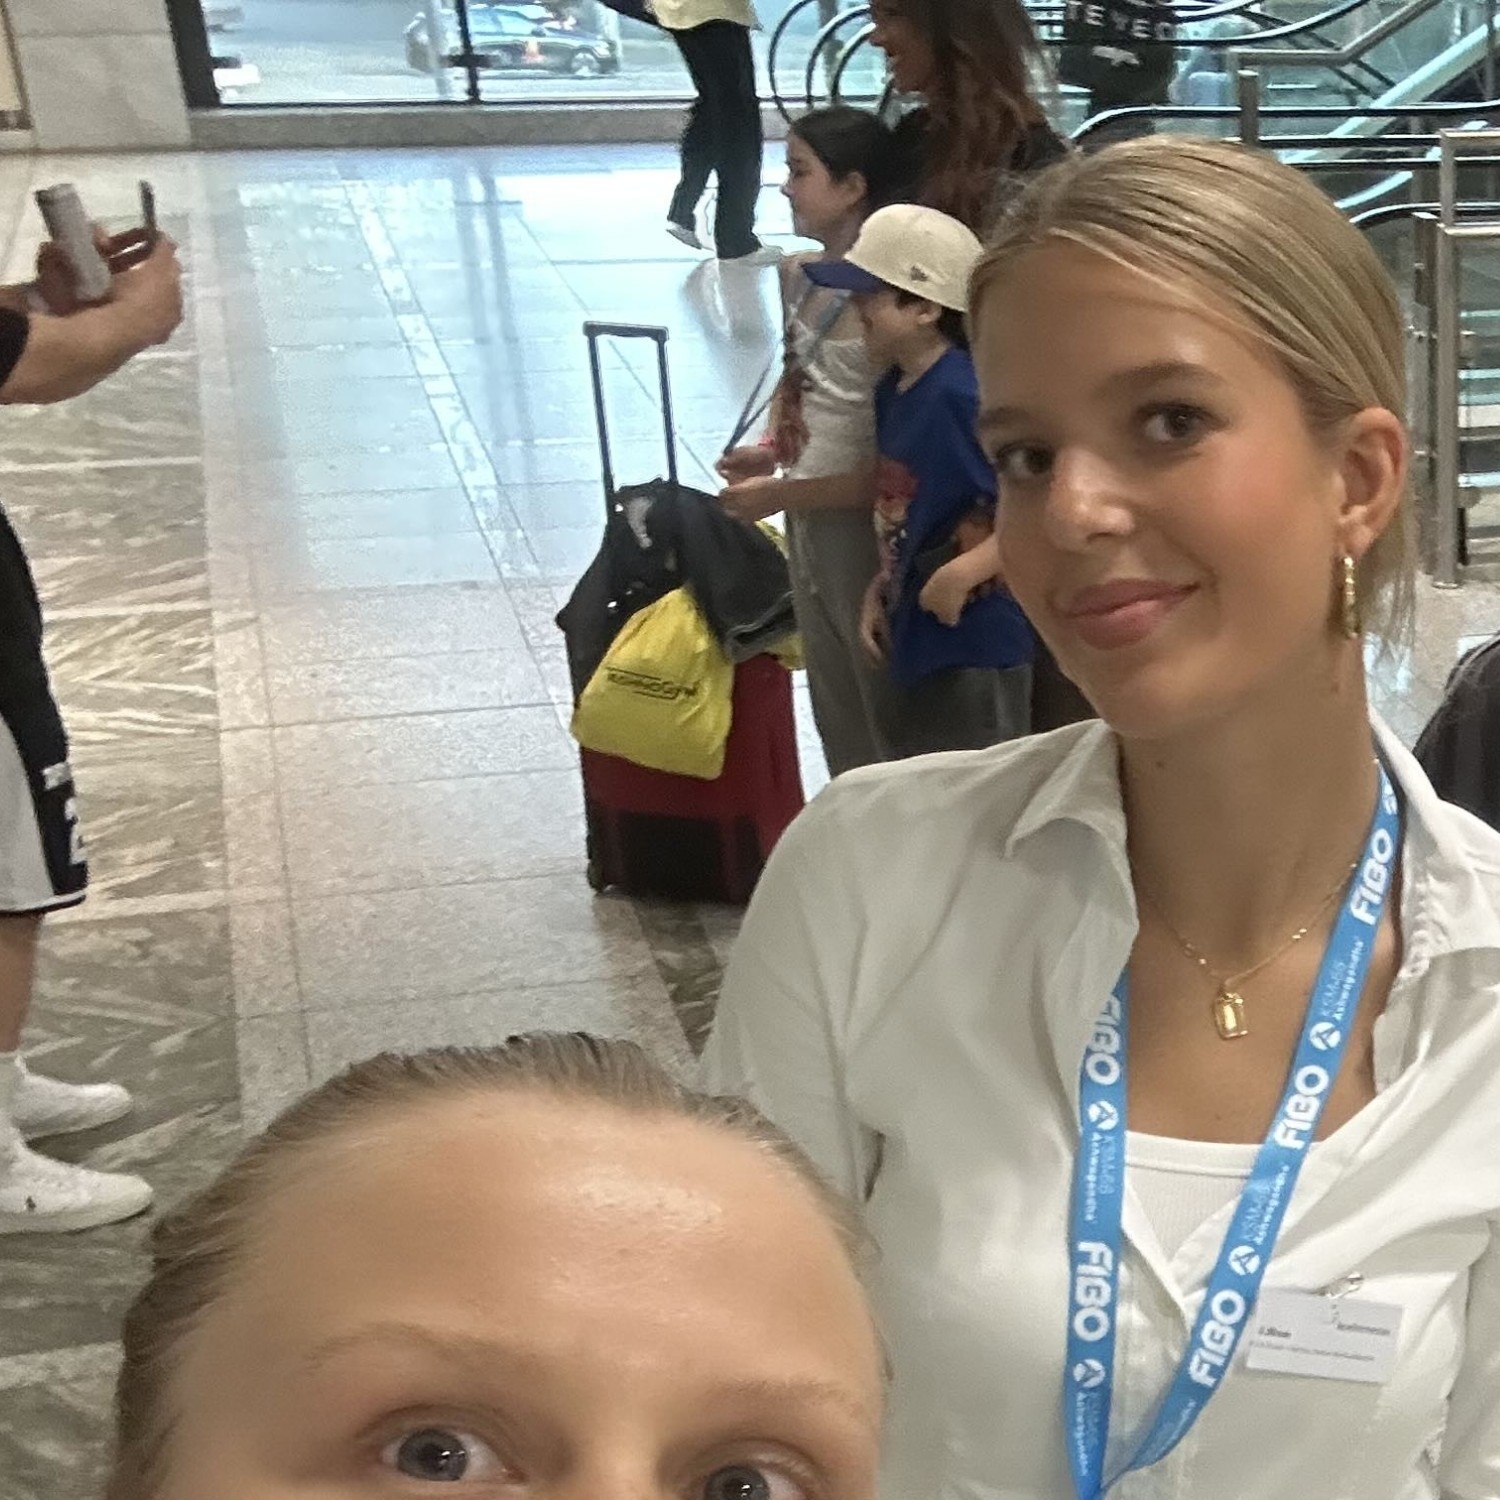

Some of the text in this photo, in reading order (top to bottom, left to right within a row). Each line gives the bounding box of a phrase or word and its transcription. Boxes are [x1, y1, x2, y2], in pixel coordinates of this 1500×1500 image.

[1350, 827, 1393, 926] FIBO
[1086, 993, 1121, 1086] FIBO
[1274, 1064, 1329, 1150] FIBO
[1073, 1241, 1113, 1342] FIBO
[1188, 1289, 1246, 1388] FIBO
